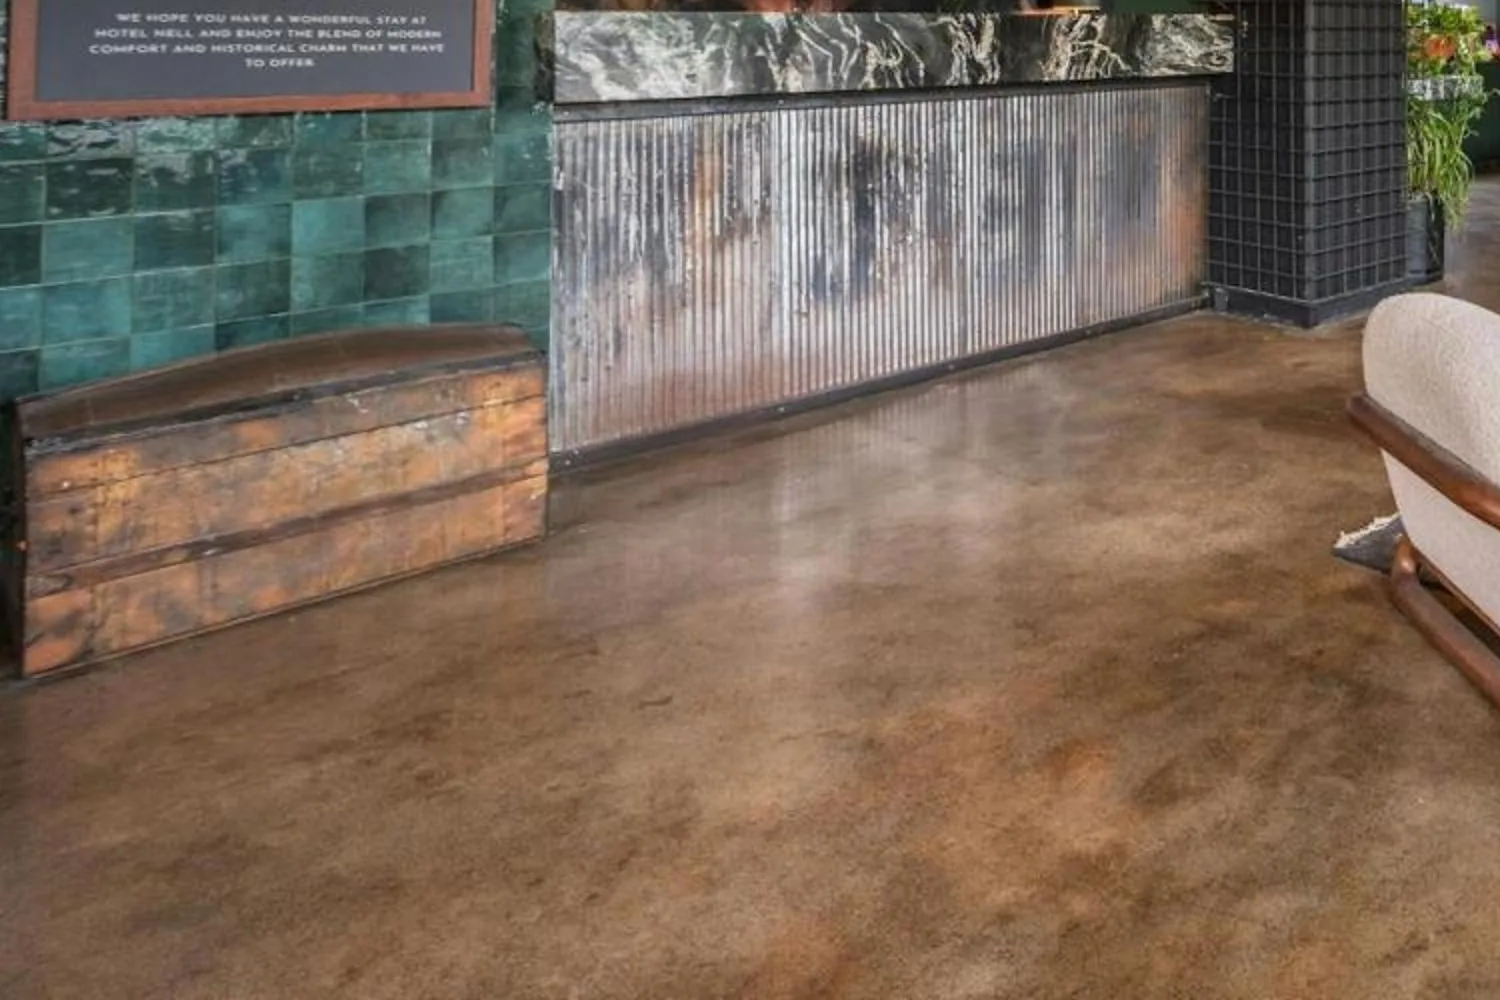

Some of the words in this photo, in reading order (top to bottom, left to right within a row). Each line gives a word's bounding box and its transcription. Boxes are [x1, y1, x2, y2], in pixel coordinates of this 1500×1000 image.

[115, 12, 141, 23] WE
[145, 12, 189, 23] HOPE
[193, 13, 226, 24] YOU
[229, 13, 270, 24] HAVE
[273, 14, 284, 24] A
[287, 14, 371, 25] WONDERFUL
[375, 15, 407, 25] STAY
[410, 15, 426, 25] AT
[93, 27, 146, 39] HOTEL
[153, 28, 192, 39] NELL
[199, 28, 231, 39] AND
[235, 28, 282, 39] ENJOY
[287, 28, 313, 39] THE
[317, 29, 361, 39] BLEND
[365, 29, 382, 39] OF
[386, 29, 442, 39] MODERN
[88, 43, 167, 54] COMFORT
[172, 43, 207, 54] AND
[210, 43, 293, 53] HISTORICAL
[299, 43, 347, 53] CHARM
[351, 42, 383, 53] THAT
[387, 42, 407, 52] WE
[410, 42, 445, 52] HAVE
[244, 57, 265, 68] TO
